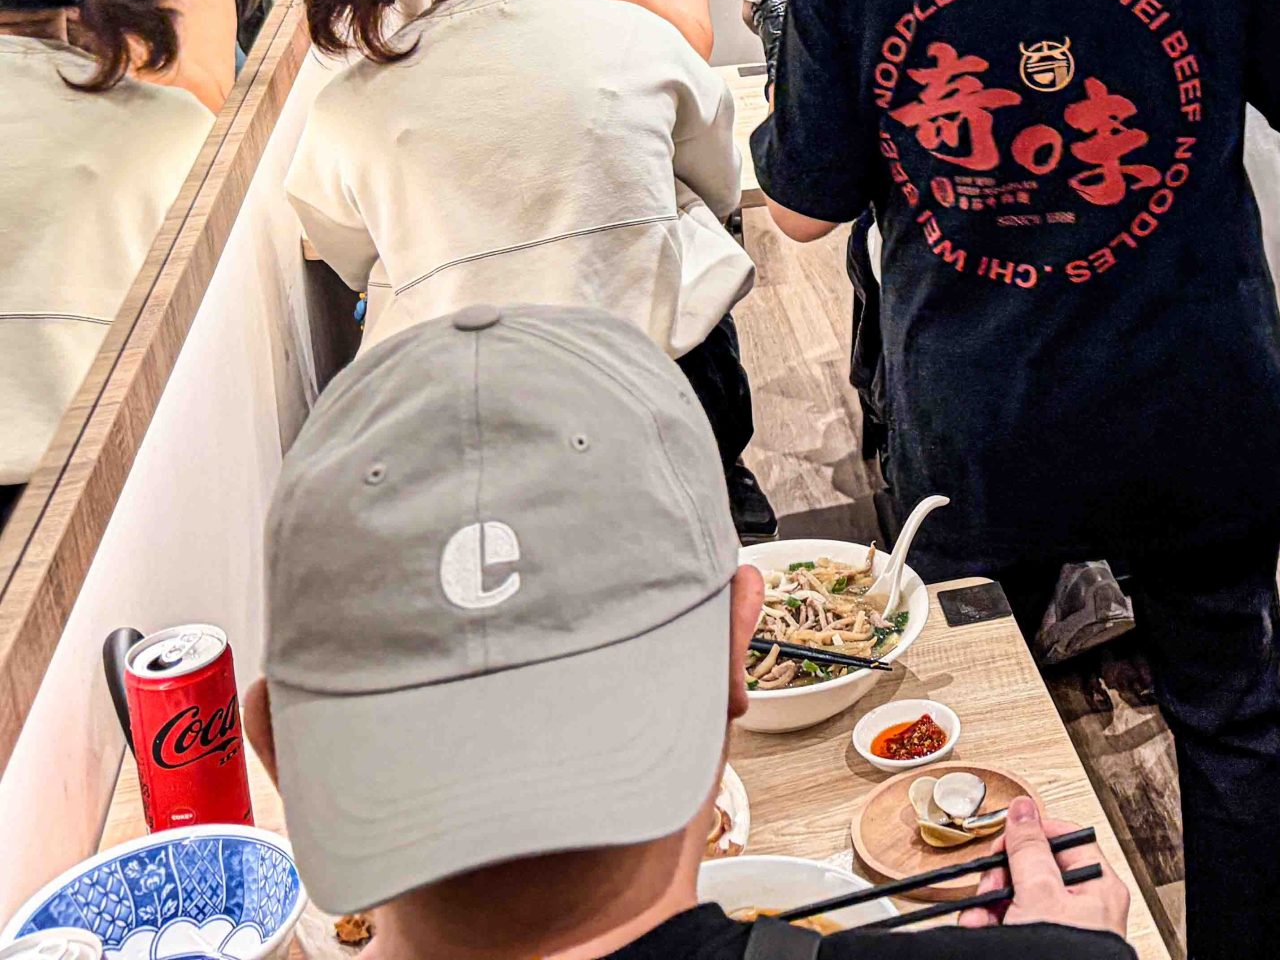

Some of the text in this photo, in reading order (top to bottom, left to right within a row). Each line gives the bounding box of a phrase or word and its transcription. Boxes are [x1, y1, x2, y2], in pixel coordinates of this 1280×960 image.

[1161, 29, 1203, 123] BEEF
[915, 209, 968, 273] WEI
[1065, 137, 1197, 283] NOODLES
[977, 256, 1038, 289] CHI
